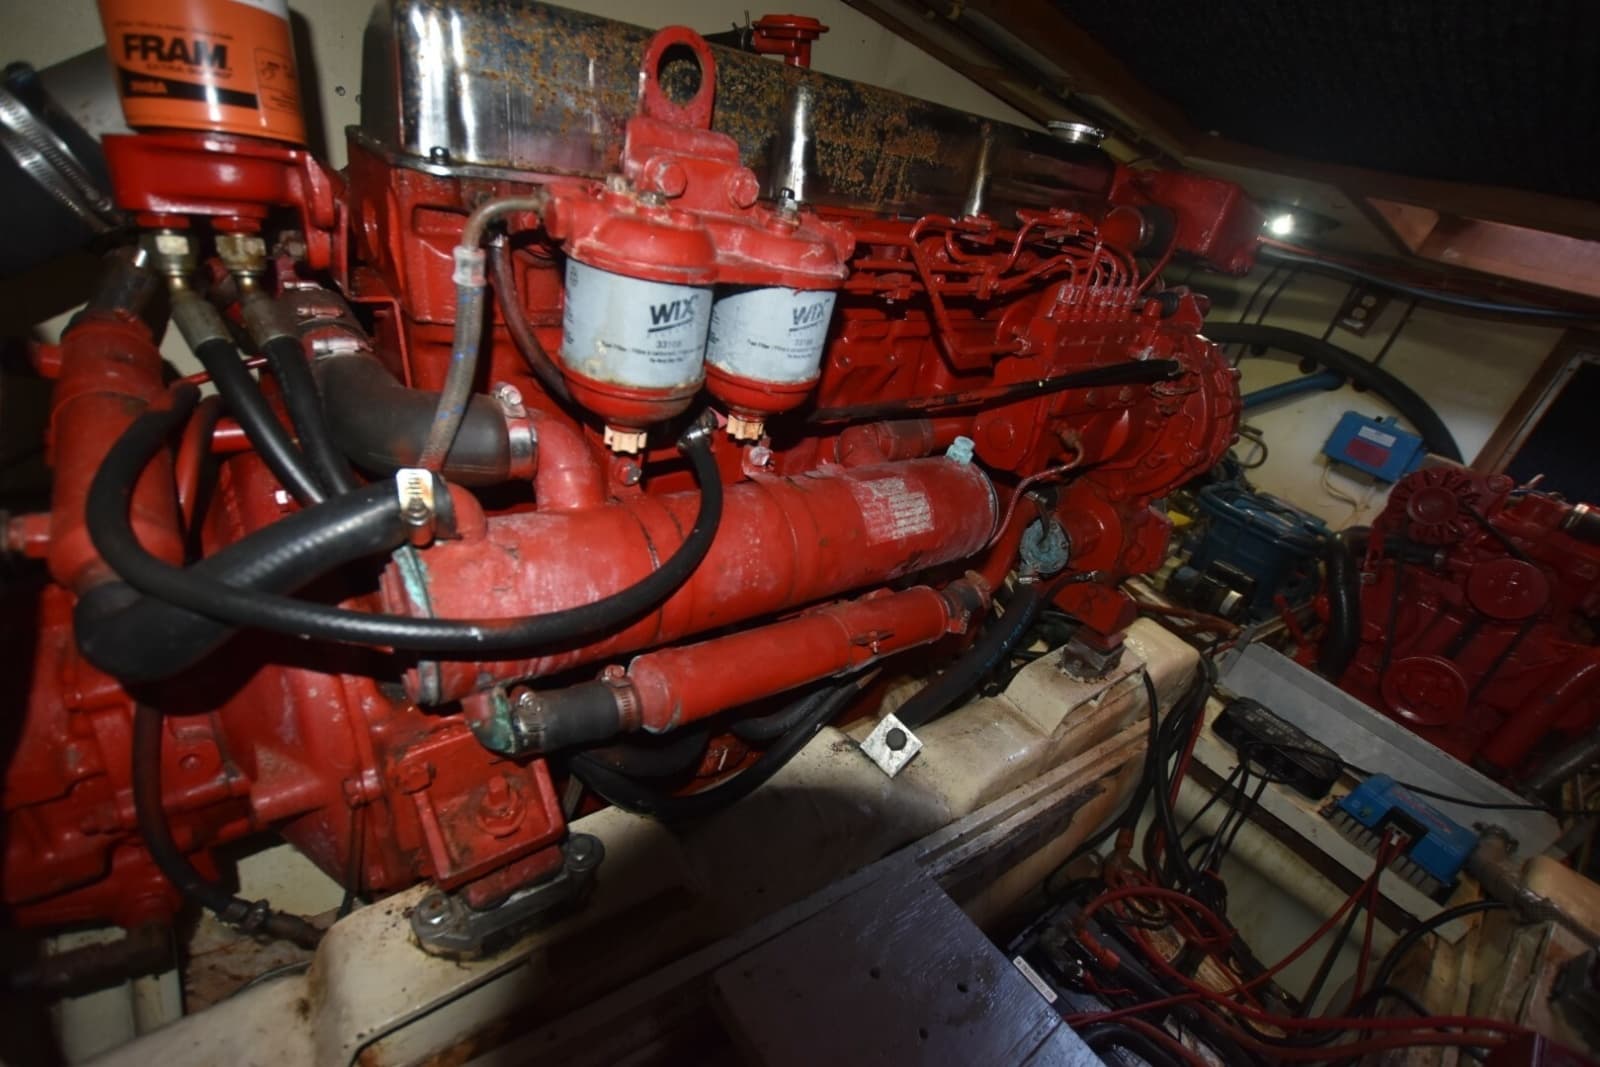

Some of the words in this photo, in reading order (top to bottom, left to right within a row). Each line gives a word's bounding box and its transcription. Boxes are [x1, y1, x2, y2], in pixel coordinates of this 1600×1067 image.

[123, 34, 227, 69] FRAM
[649, 298, 695, 326] WIX
[793, 302, 825, 325] WIX
